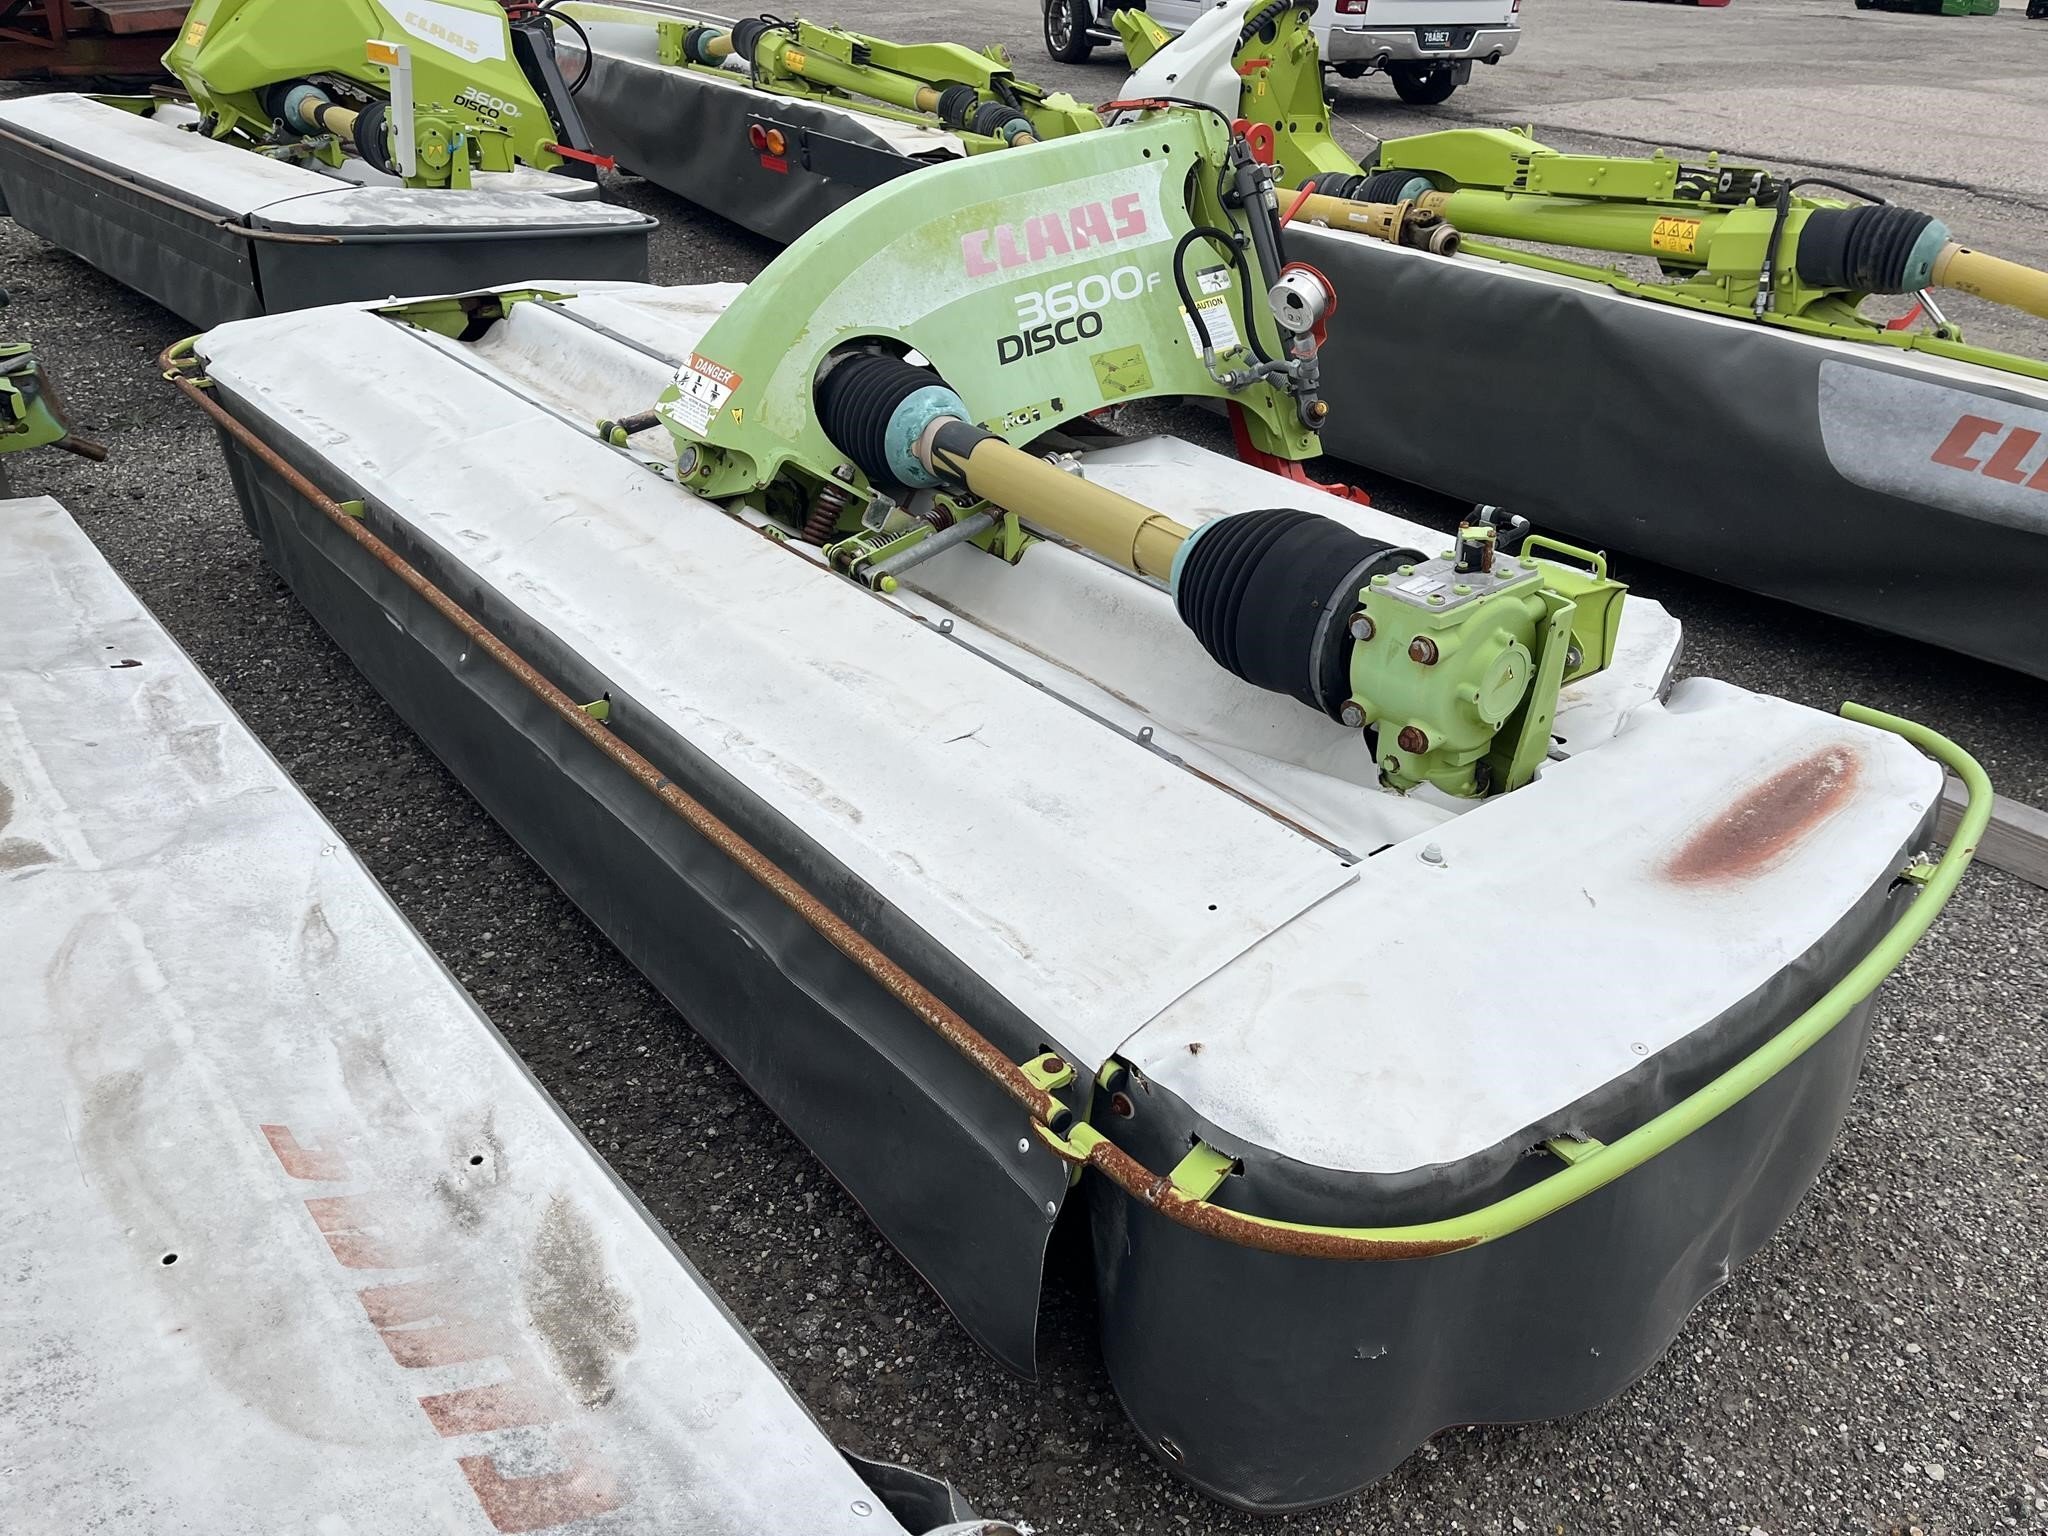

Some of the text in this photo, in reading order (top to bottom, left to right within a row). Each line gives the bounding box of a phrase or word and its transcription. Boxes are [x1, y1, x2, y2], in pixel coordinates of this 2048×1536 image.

[405, 11, 479, 55] CLAAS
[453, 94, 500, 119] DISCO
[961, 192, 1147, 278] CLAAS
[1196, 297, 1223, 310] AUTION
[997, 311, 1103, 366] DISCO
[694, 358, 733, 385] DANGER
[1930, 414, 2048, 493] CL
